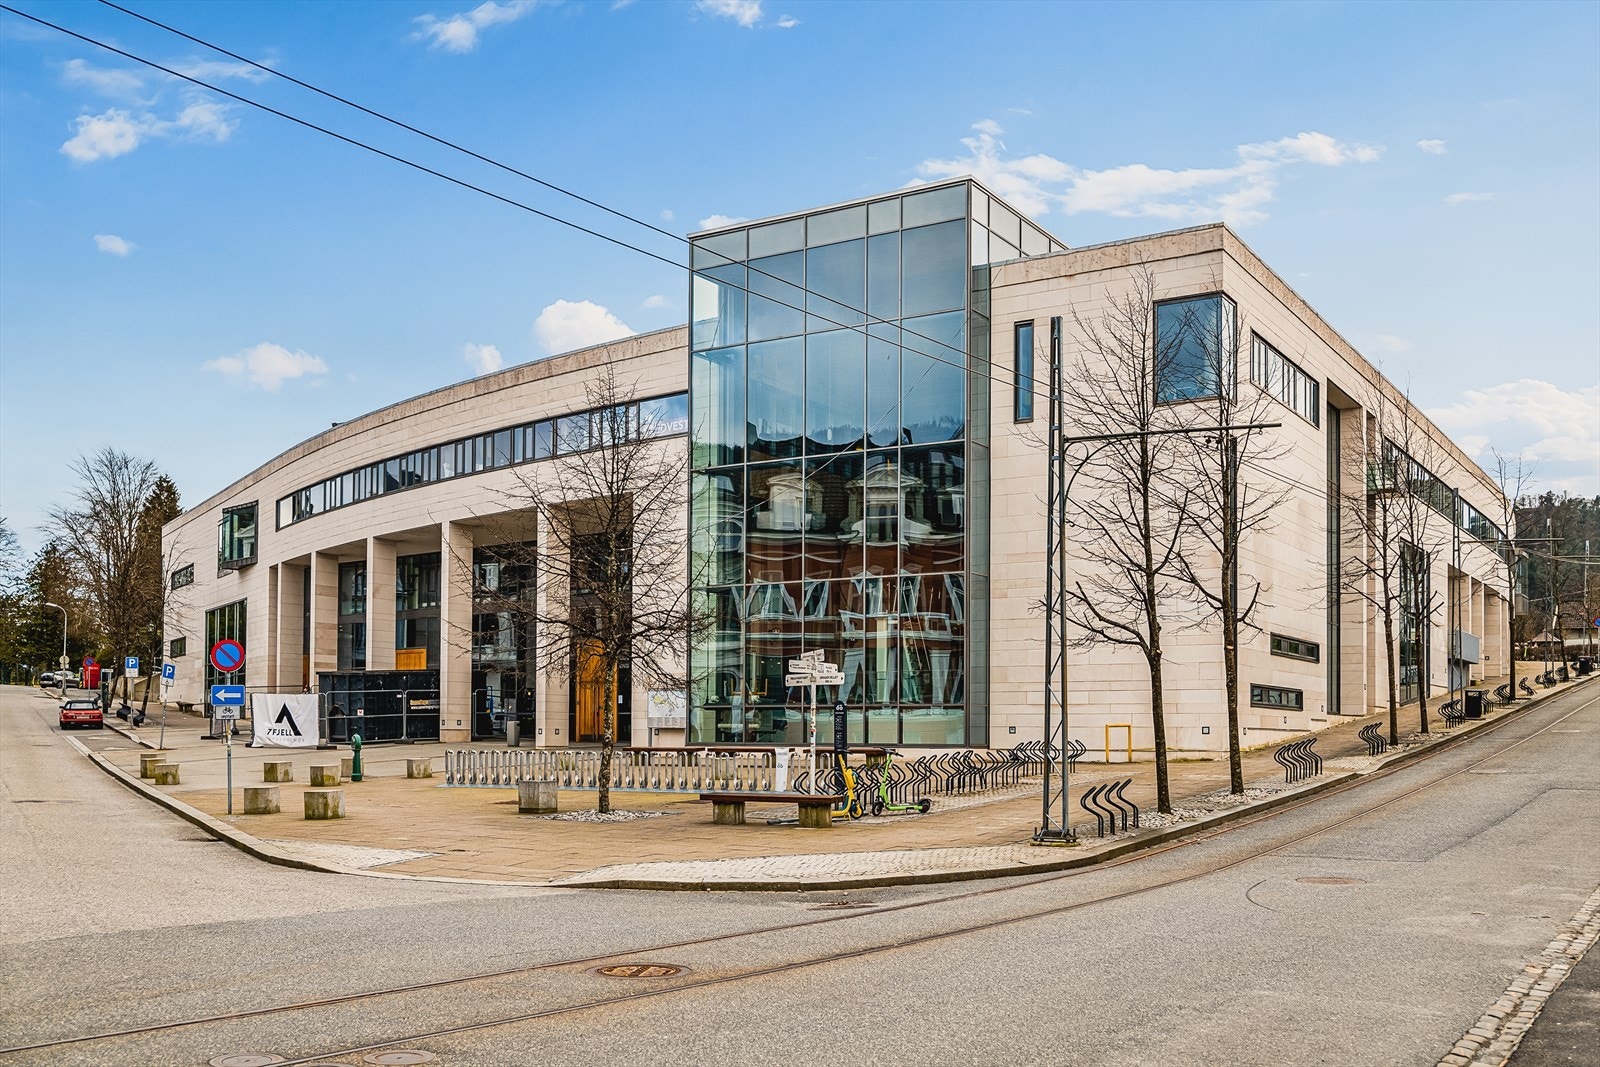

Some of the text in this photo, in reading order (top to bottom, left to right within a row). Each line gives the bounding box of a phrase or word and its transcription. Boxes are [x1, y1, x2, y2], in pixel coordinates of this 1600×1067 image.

[129, 659, 136, 667] P
[166, 666, 173, 676] P
[267, 728, 293, 736] 7FJELL
